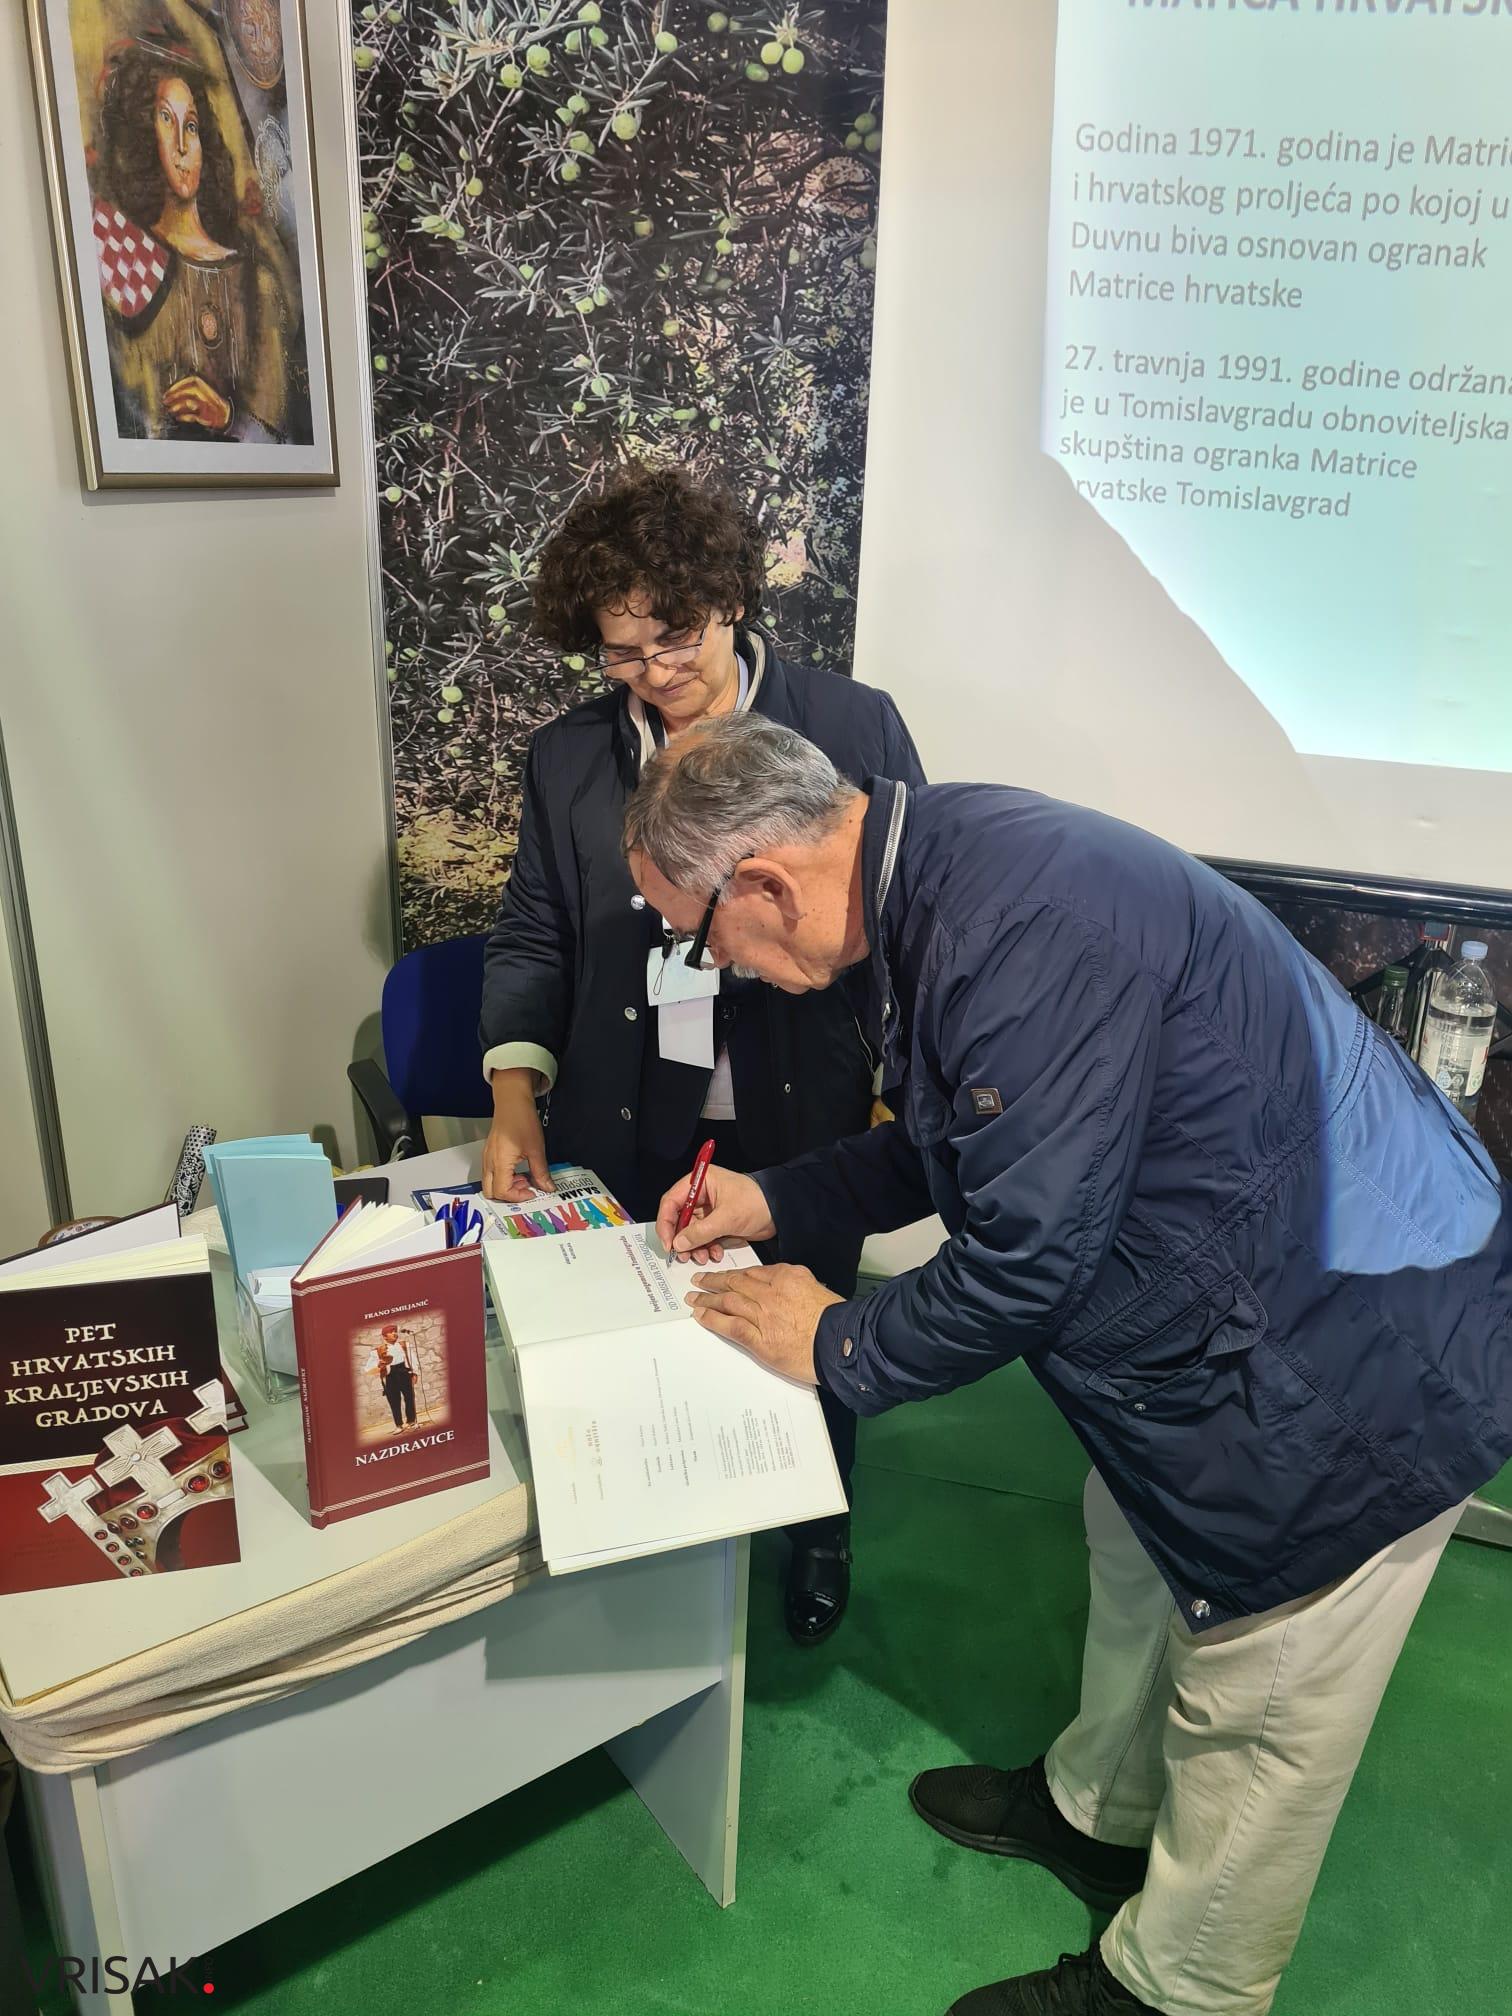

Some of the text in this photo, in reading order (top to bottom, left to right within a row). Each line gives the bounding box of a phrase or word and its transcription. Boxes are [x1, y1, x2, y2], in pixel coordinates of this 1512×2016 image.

[1076, 123, 1512, 170] Godina 1971. godina je Matri
[1073, 172, 1509, 225] i hrvatskog proljeća po kojoj u
[1071, 221, 1488, 271] Duvnu biva osnovan ogranak
[1069, 269, 1303, 308] Matrice hrvatske
[1064, 345, 1103, 372] 27.
[1113, 349, 1205, 384] travnja
[1217, 354, 1292, 384] 1991.
[1301, 360, 1401, 392] godine
[1059, 389, 1510, 445] je u Tomislavgradu obnoviteljska
[1059, 430, 1418, 479] skupština ogranka Matrice
[1076, 477, 1351, 520] rvatske Tomislavgrad
[559, 1186, 601, 1201] SAJAM
[64, 1323, 117, 1343] PET
[10, 1345, 177, 1377] HRVATSKIH
[4, 1370, 189, 1406] KRALJEVSKIH
[35, 1399, 168, 1428] GRADOVA
[355, 1430, 455, 1467] NAZDRAVICE
